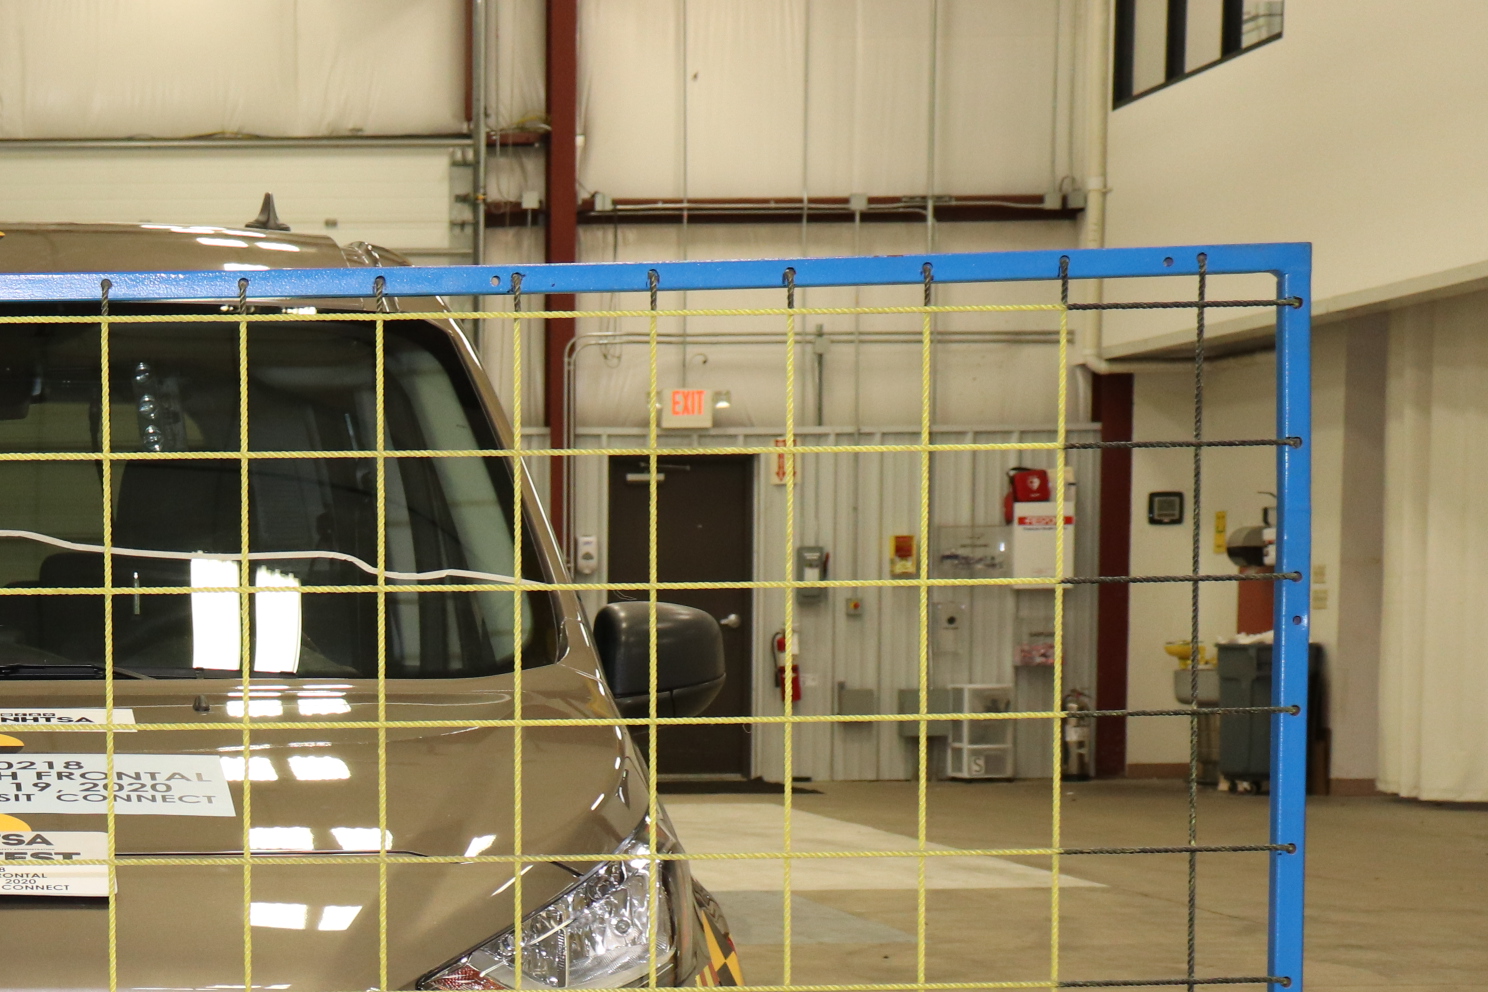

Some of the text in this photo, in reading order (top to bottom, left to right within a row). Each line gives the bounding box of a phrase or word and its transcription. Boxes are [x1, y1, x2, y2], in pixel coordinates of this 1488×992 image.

[672, 390, 706, 415] EXIT
[36, 771, 212, 782] FRONTAL
[11, 782, 63, 794] 19,
[79, 782, 173, 793] 2020
[56, 793, 217, 804] CONNECT
